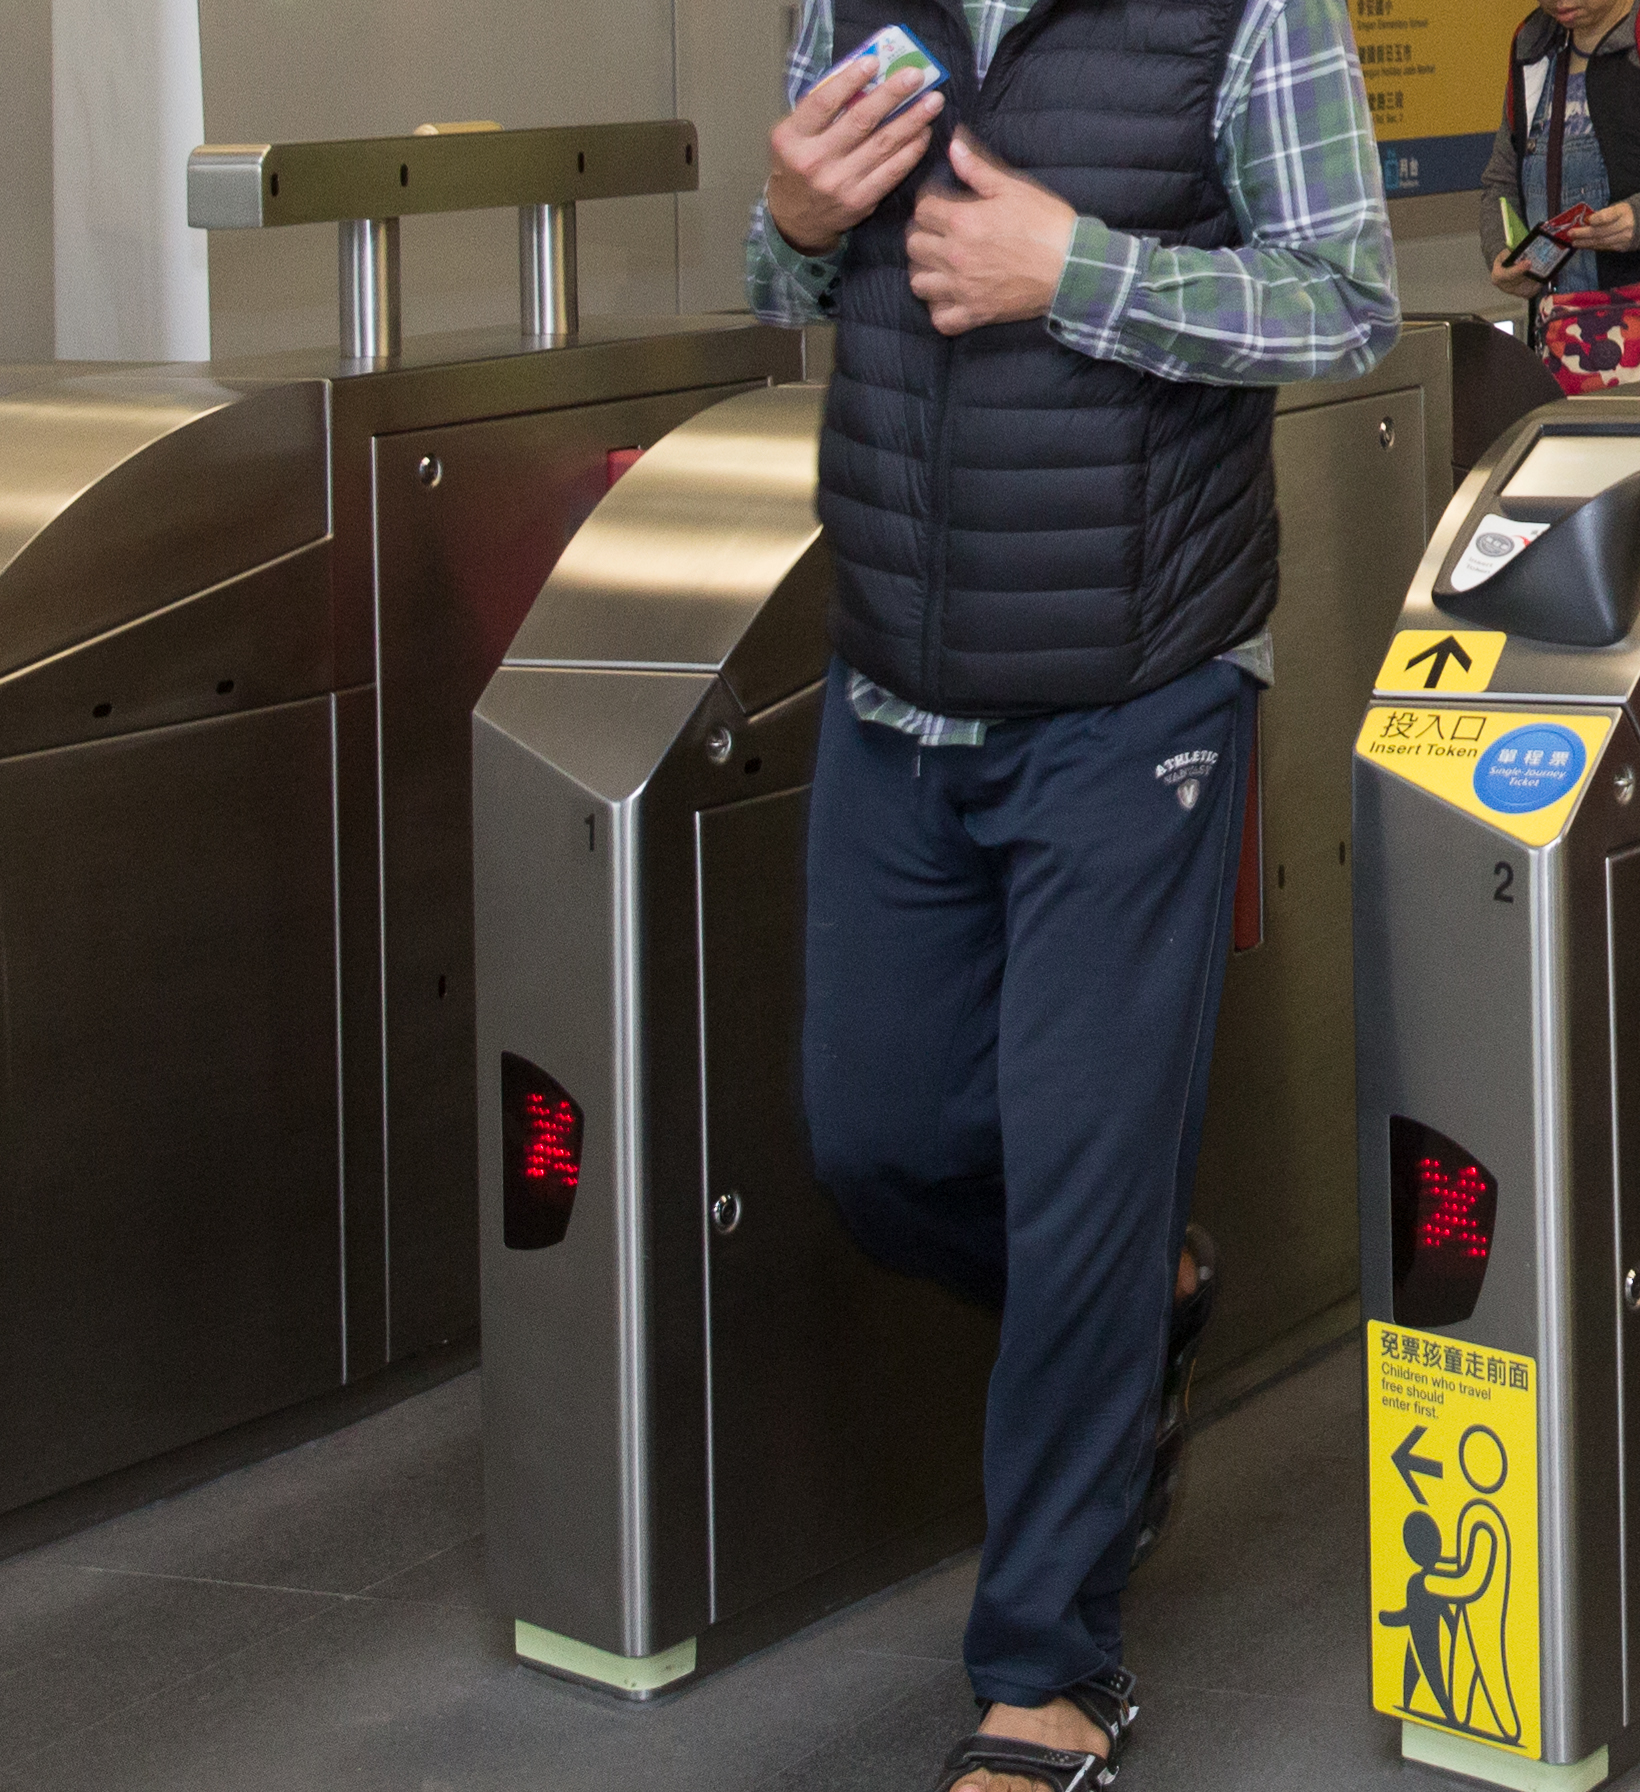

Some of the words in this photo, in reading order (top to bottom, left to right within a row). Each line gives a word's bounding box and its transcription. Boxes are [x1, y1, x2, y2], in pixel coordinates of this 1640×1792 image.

[1379, 711, 1487, 741] 投入口
[1369, 741, 1421, 755] Insert
[1427, 743, 1478, 758] Token
[1498, 748, 1570, 766] 單程票
[1155, 750, 1219, 779] ATHLETIC
[1509, 776, 1540, 787] Ticket
[584, 813, 596, 852] 1
[1493, 861, 1515, 904] 2
[1381, 1329, 1529, 1392] 免票孩童走前面
[1381, 1362, 1428, 1383] Children
[1431, 1372, 1456, 1389] who
[1459, 1379, 1492, 1400] travel
[1381, 1378, 1403, 1395] free
[1406, 1383, 1445, 1405] should
[1381, 1395, 1411, 1411] enter
[1413, 1400, 1440, 1419] first.
